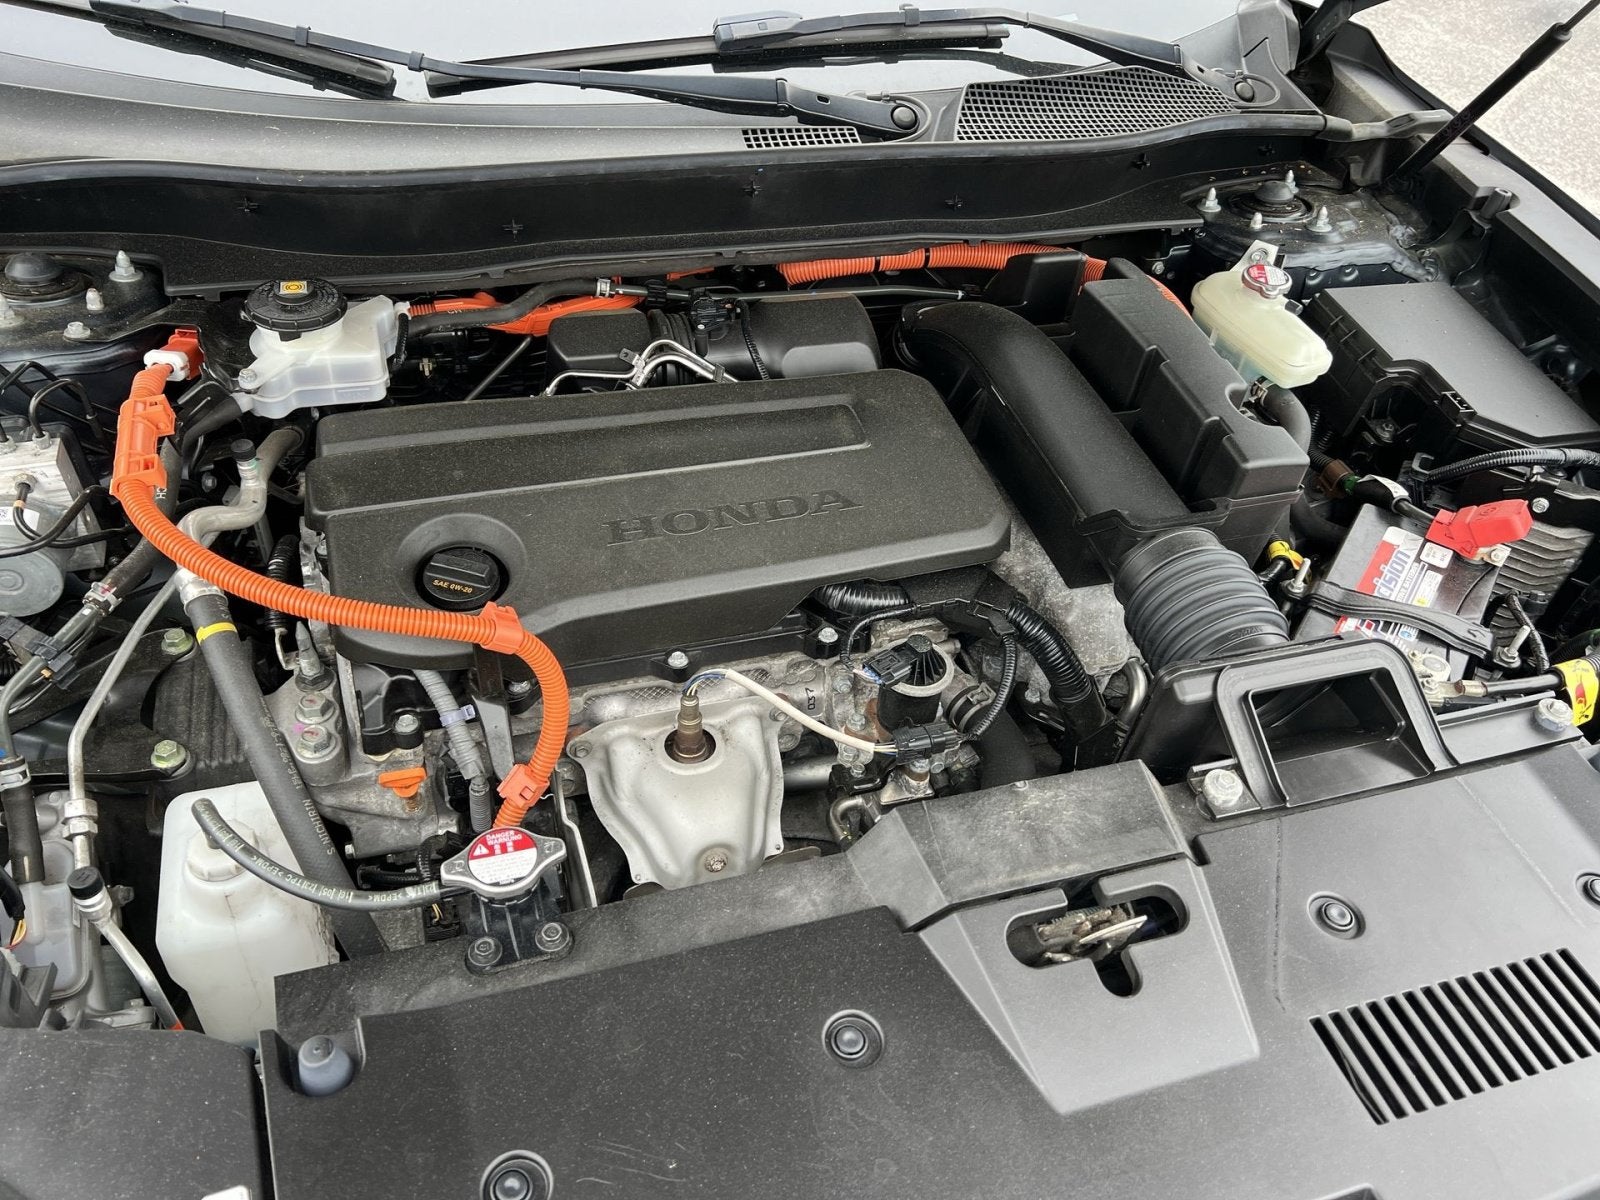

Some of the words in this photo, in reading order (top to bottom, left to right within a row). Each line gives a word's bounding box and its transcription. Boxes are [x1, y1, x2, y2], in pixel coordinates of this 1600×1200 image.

[601, 489, 865, 546] HONDA
[432, 579, 449, 588] SAE
[450, 583, 473, 594] 0W-20
[303, 799, 331, 846] NICHIRIN
[486, 830, 515, 841] DANGER
